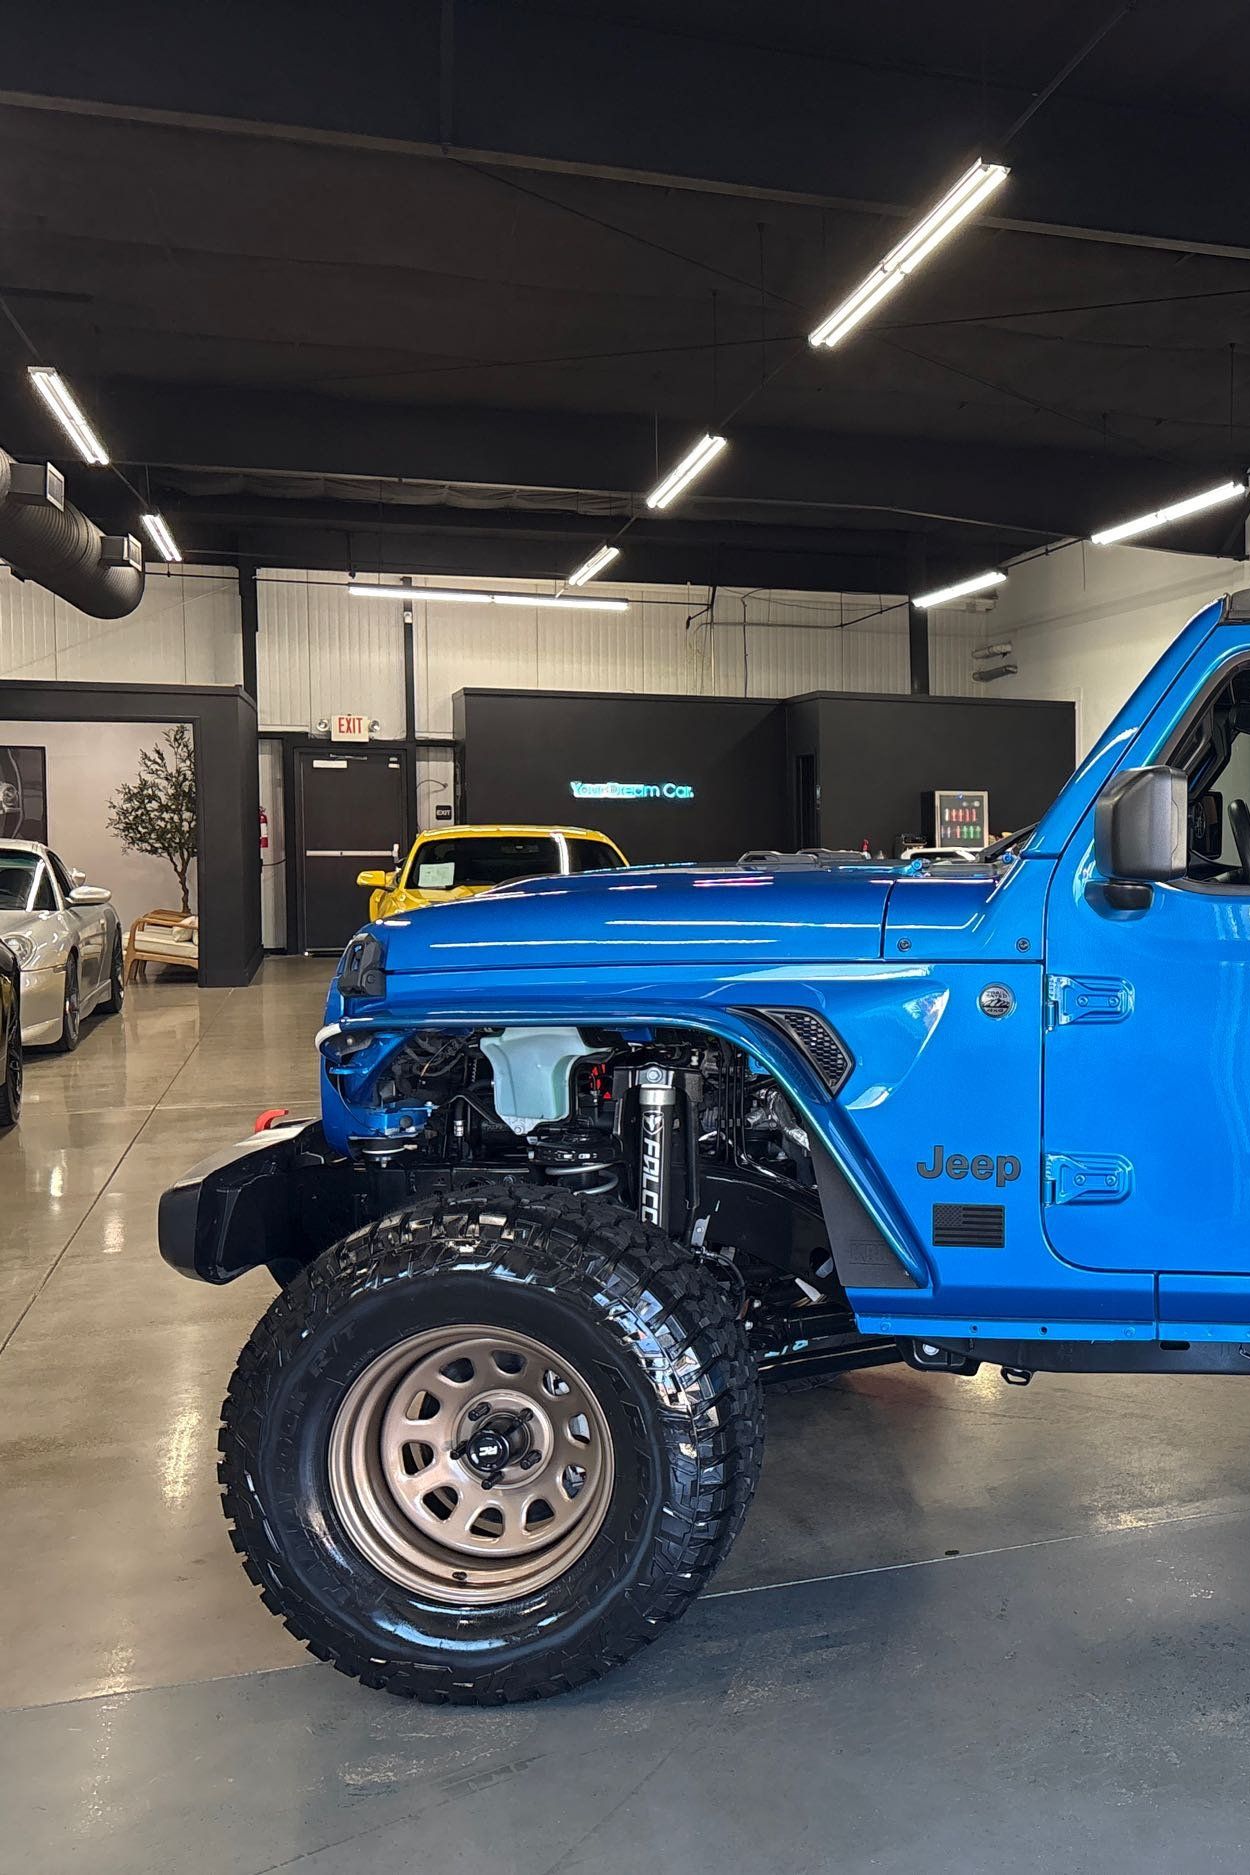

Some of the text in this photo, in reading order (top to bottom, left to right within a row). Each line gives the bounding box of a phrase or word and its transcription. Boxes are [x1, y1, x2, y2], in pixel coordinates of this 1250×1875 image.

[338, 717, 363, 734] EXIT
[570, 781, 605, 798] Your
[607, 782, 660, 798] Dream
[917, 1145, 1021, 1188] Jeep
[641, 1138, 660, 1226] FALCO
[479, 1445, 499, 1457] RC
